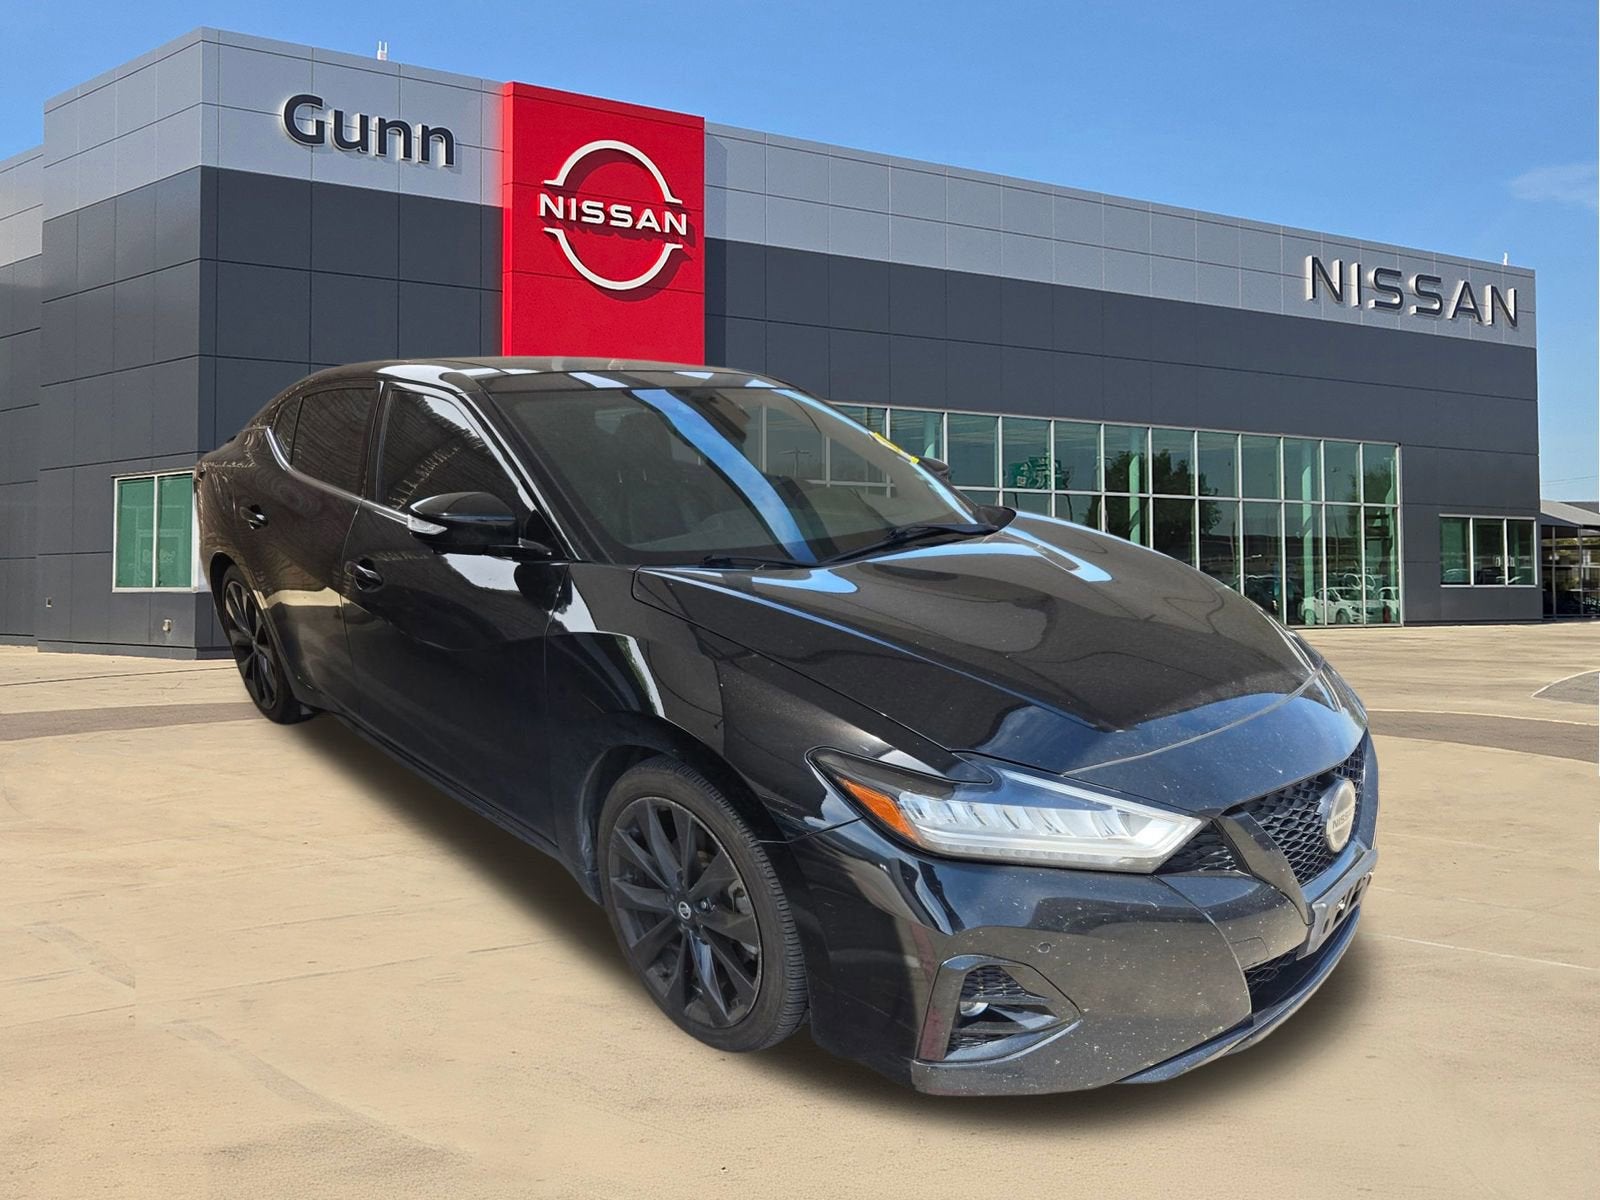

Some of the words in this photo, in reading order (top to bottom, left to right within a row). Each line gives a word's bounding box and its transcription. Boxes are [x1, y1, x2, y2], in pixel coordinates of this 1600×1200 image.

[282, 94, 455, 167] Gunn
[538, 193, 687, 236] NISSAN
[1305, 255, 1518, 328] NISSAN
